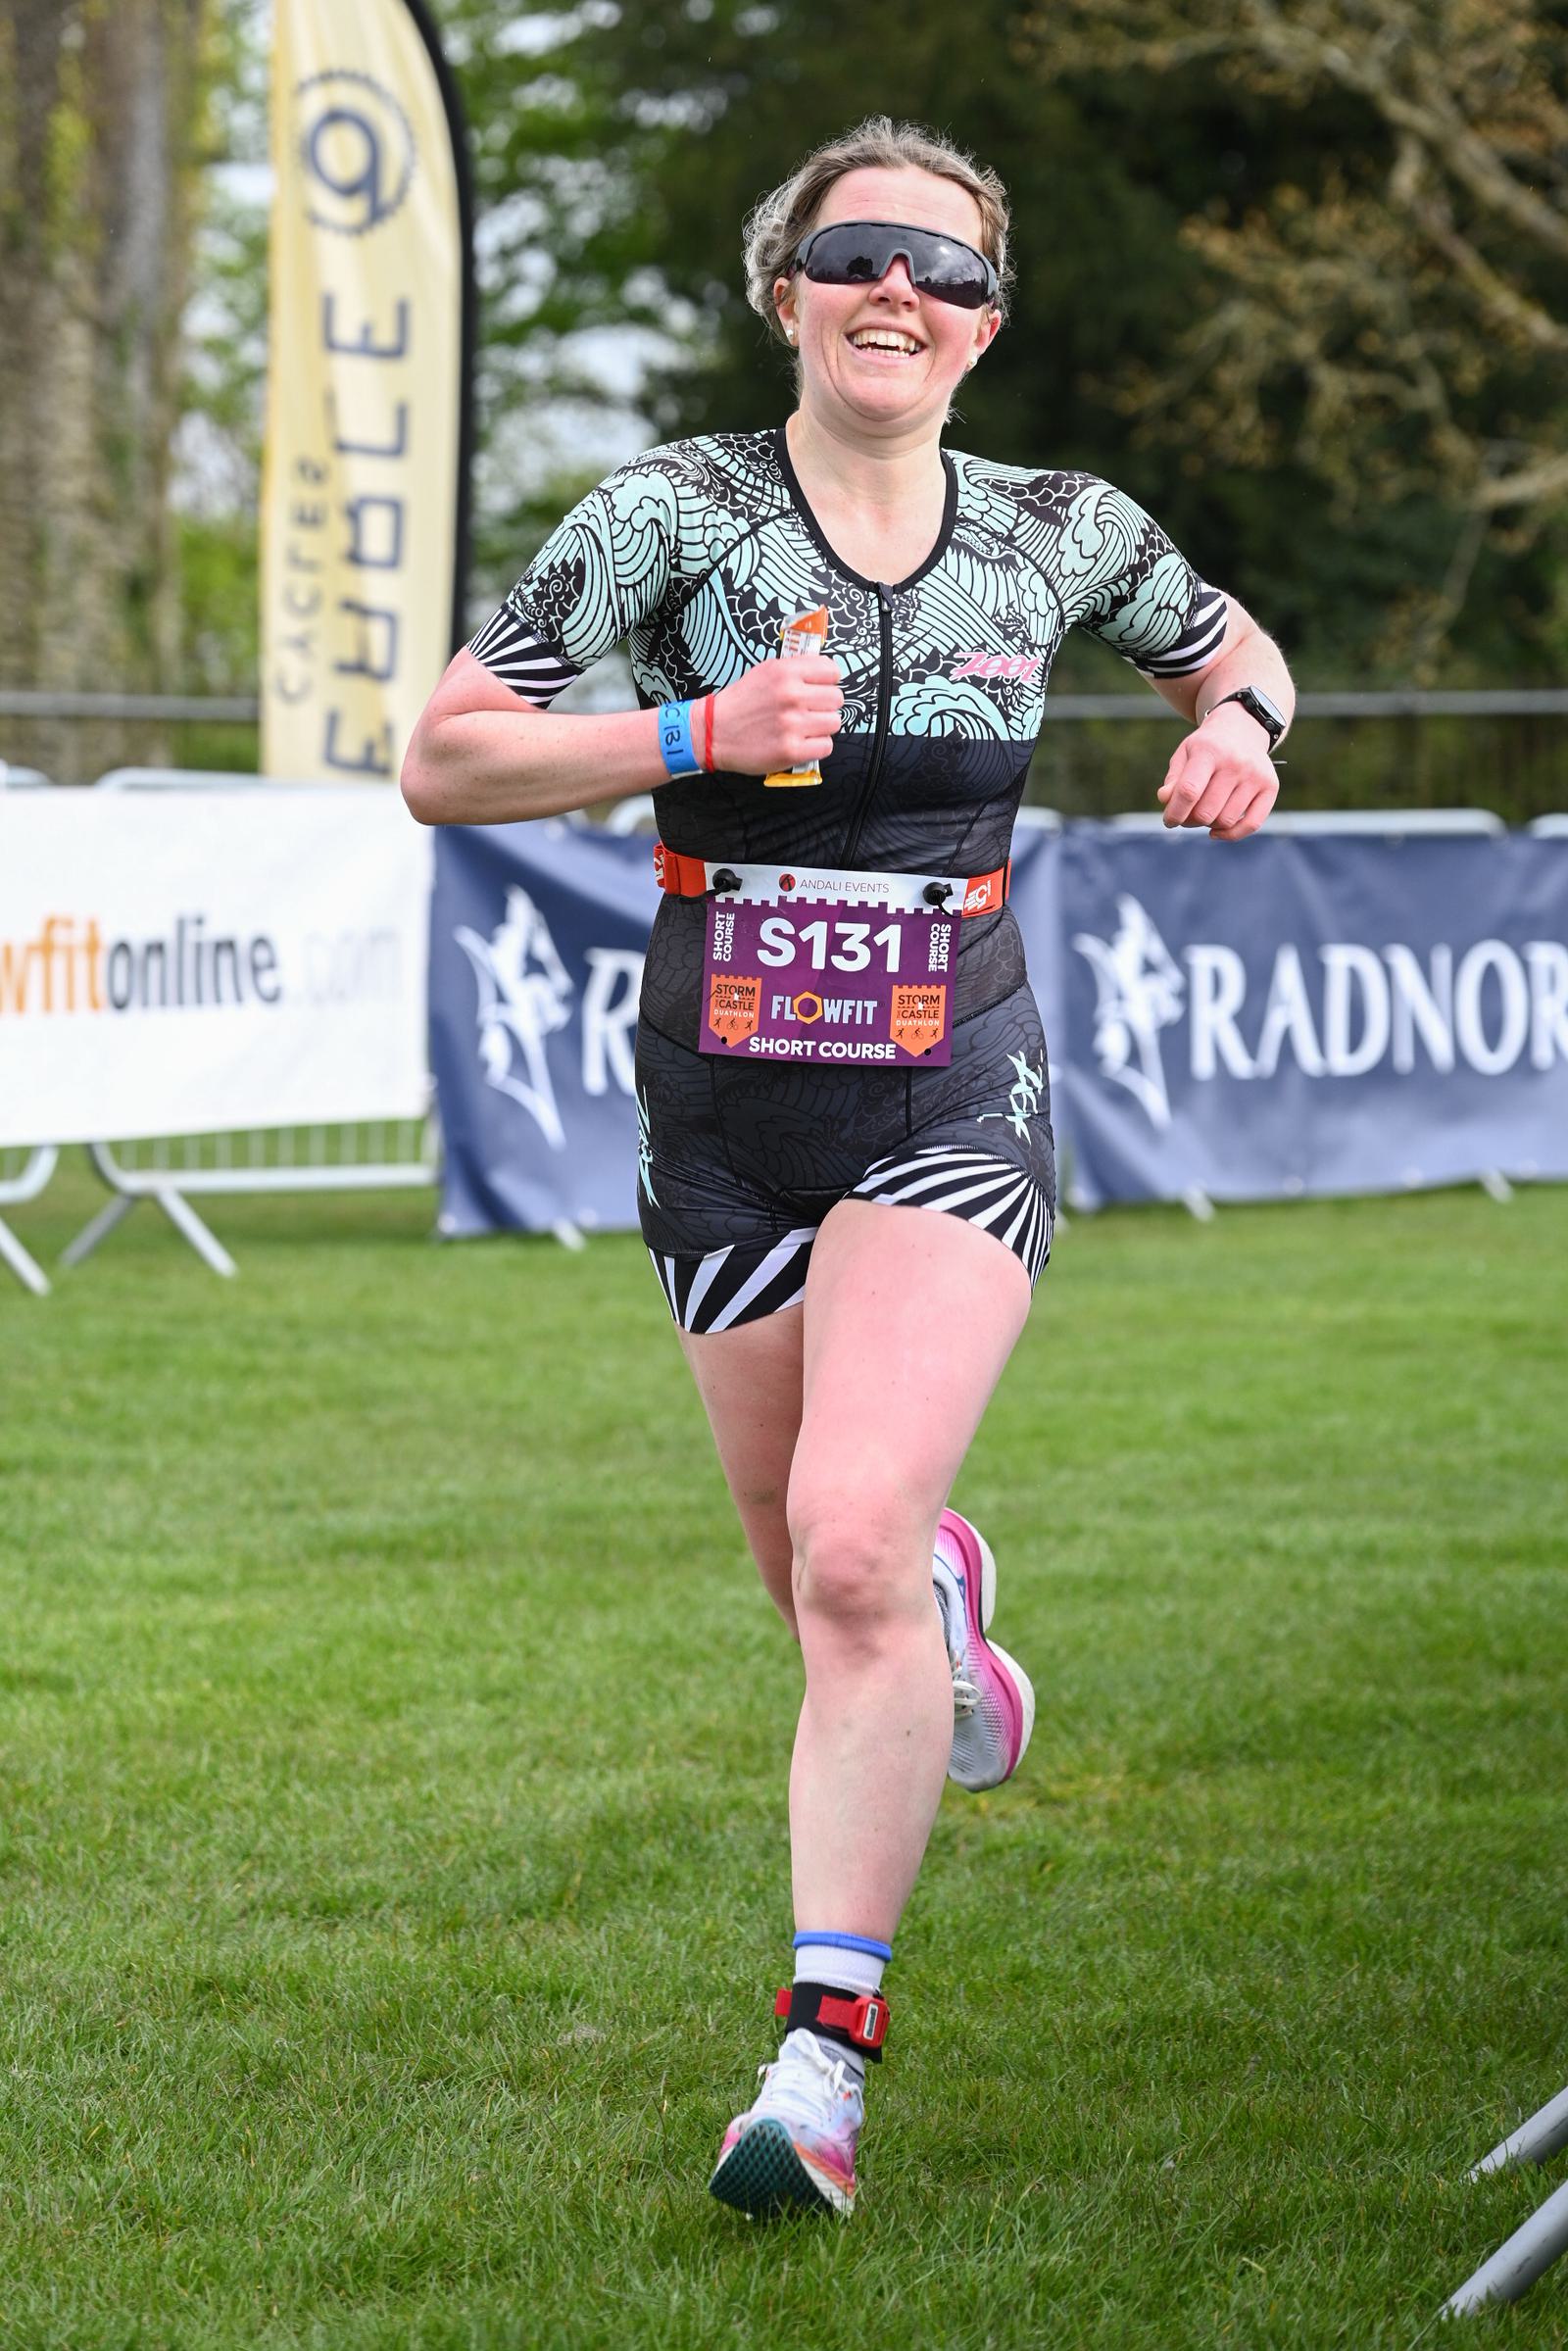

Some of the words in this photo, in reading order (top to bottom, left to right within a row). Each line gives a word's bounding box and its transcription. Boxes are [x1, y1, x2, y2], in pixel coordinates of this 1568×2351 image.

[800, 879, 843, 893] ANDALI
[845, 881, 890, 894] EVENTS
[712, 911, 726, 961] SHORT
[722, 912, 735, 962] COURSE
[757, 917, 902, 973] S131
[928, 923, 941, 973] COURSE
[937, 924, 952, 973] SHORT
[716, 984, 756, 998] STORM
[898, 994, 940, 1005] STORM
[713, 1008, 755, 1018] DUATHLON
[718, 999, 755, 1011] CASTLE
[770, 991, 878, 1026] FLOWFIT
[901, 1009, 940, 1019] CASTLE
[749, 1036, 816, 1057] SHORT
[818, 1041, 897, 1059] COURSE
